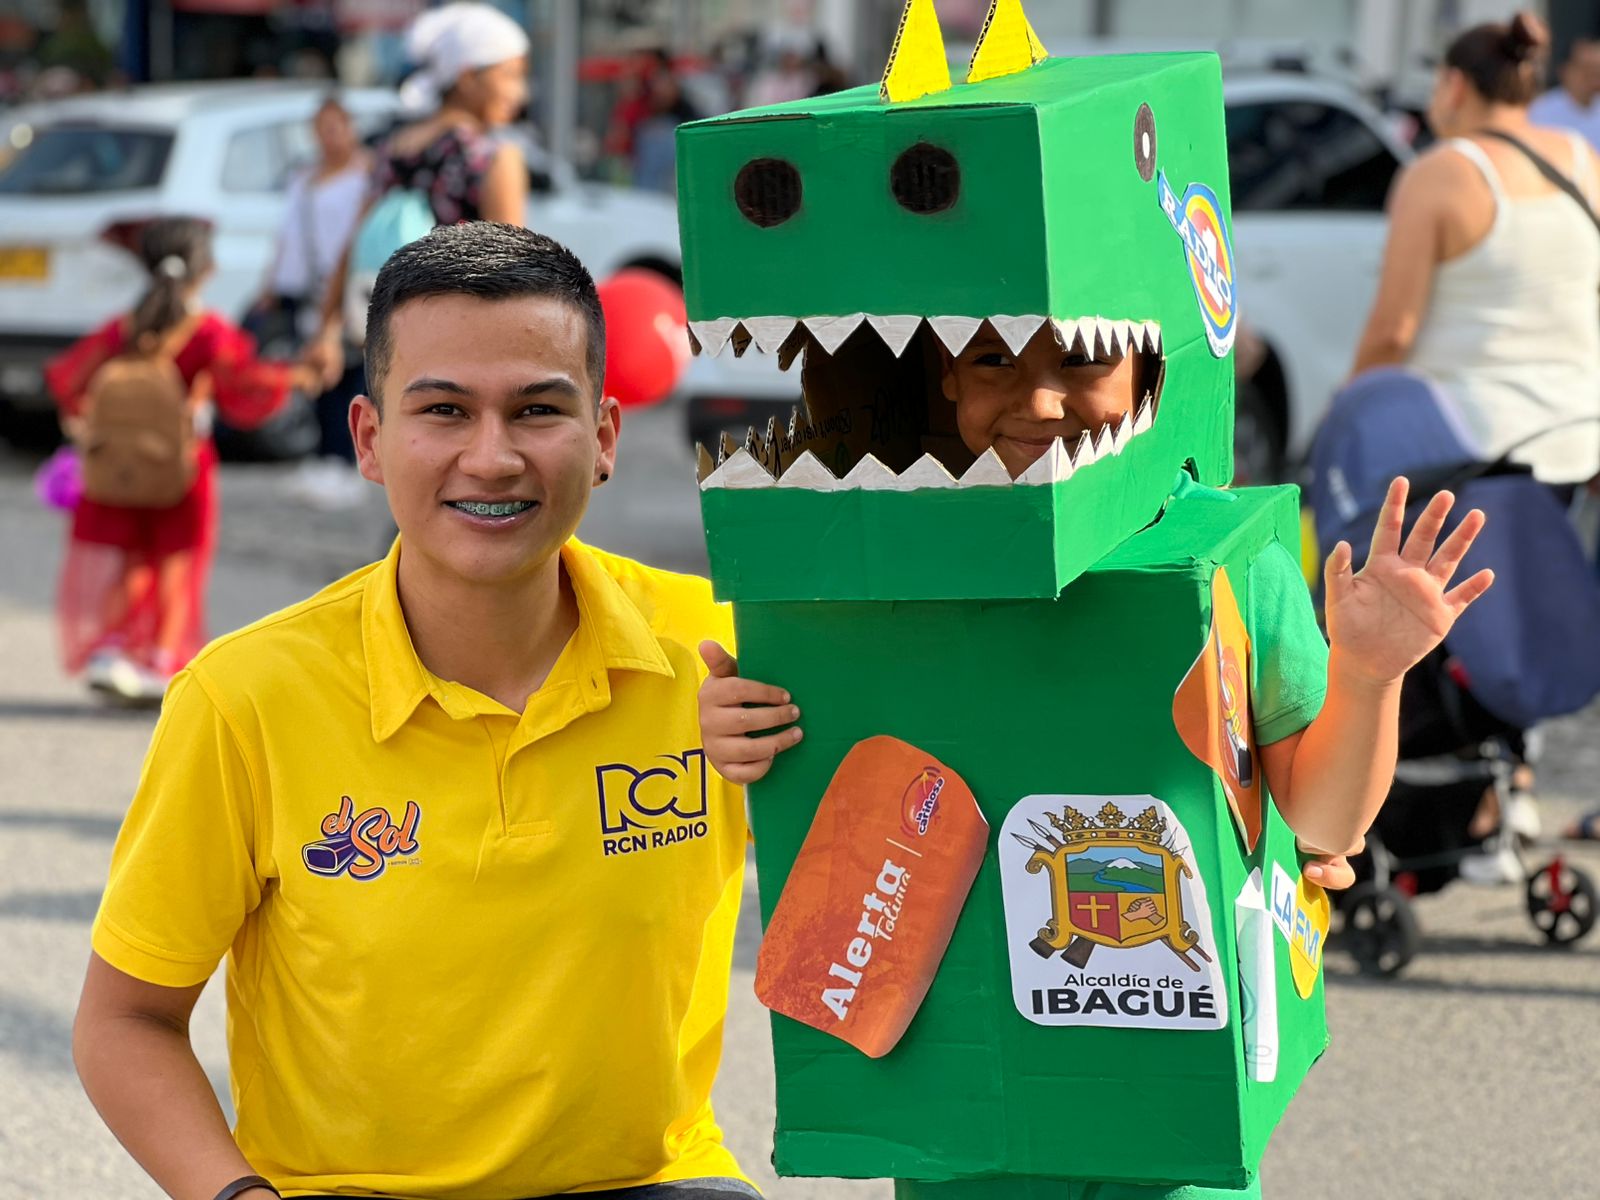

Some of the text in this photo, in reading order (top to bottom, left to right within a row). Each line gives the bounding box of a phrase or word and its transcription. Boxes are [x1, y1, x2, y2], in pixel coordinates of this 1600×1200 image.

[1162, 184, 1232, 306] RADIO
[321, 796, 352, 836] el
[919, 778, 944, 833] cariñosa
[348, 801, 419, 878] Sol
[603, 821, 708, 856] RCN RADIO
[872, 872, 911, 940] Tolima
[1274, 875, 1320, 964] LA FM
[820, 858, 905, 1020] Alerta
[1031, 985, 1217, 1019] IBAGUÉ
[1064, 974, 1184, 989] Alcaldía de
